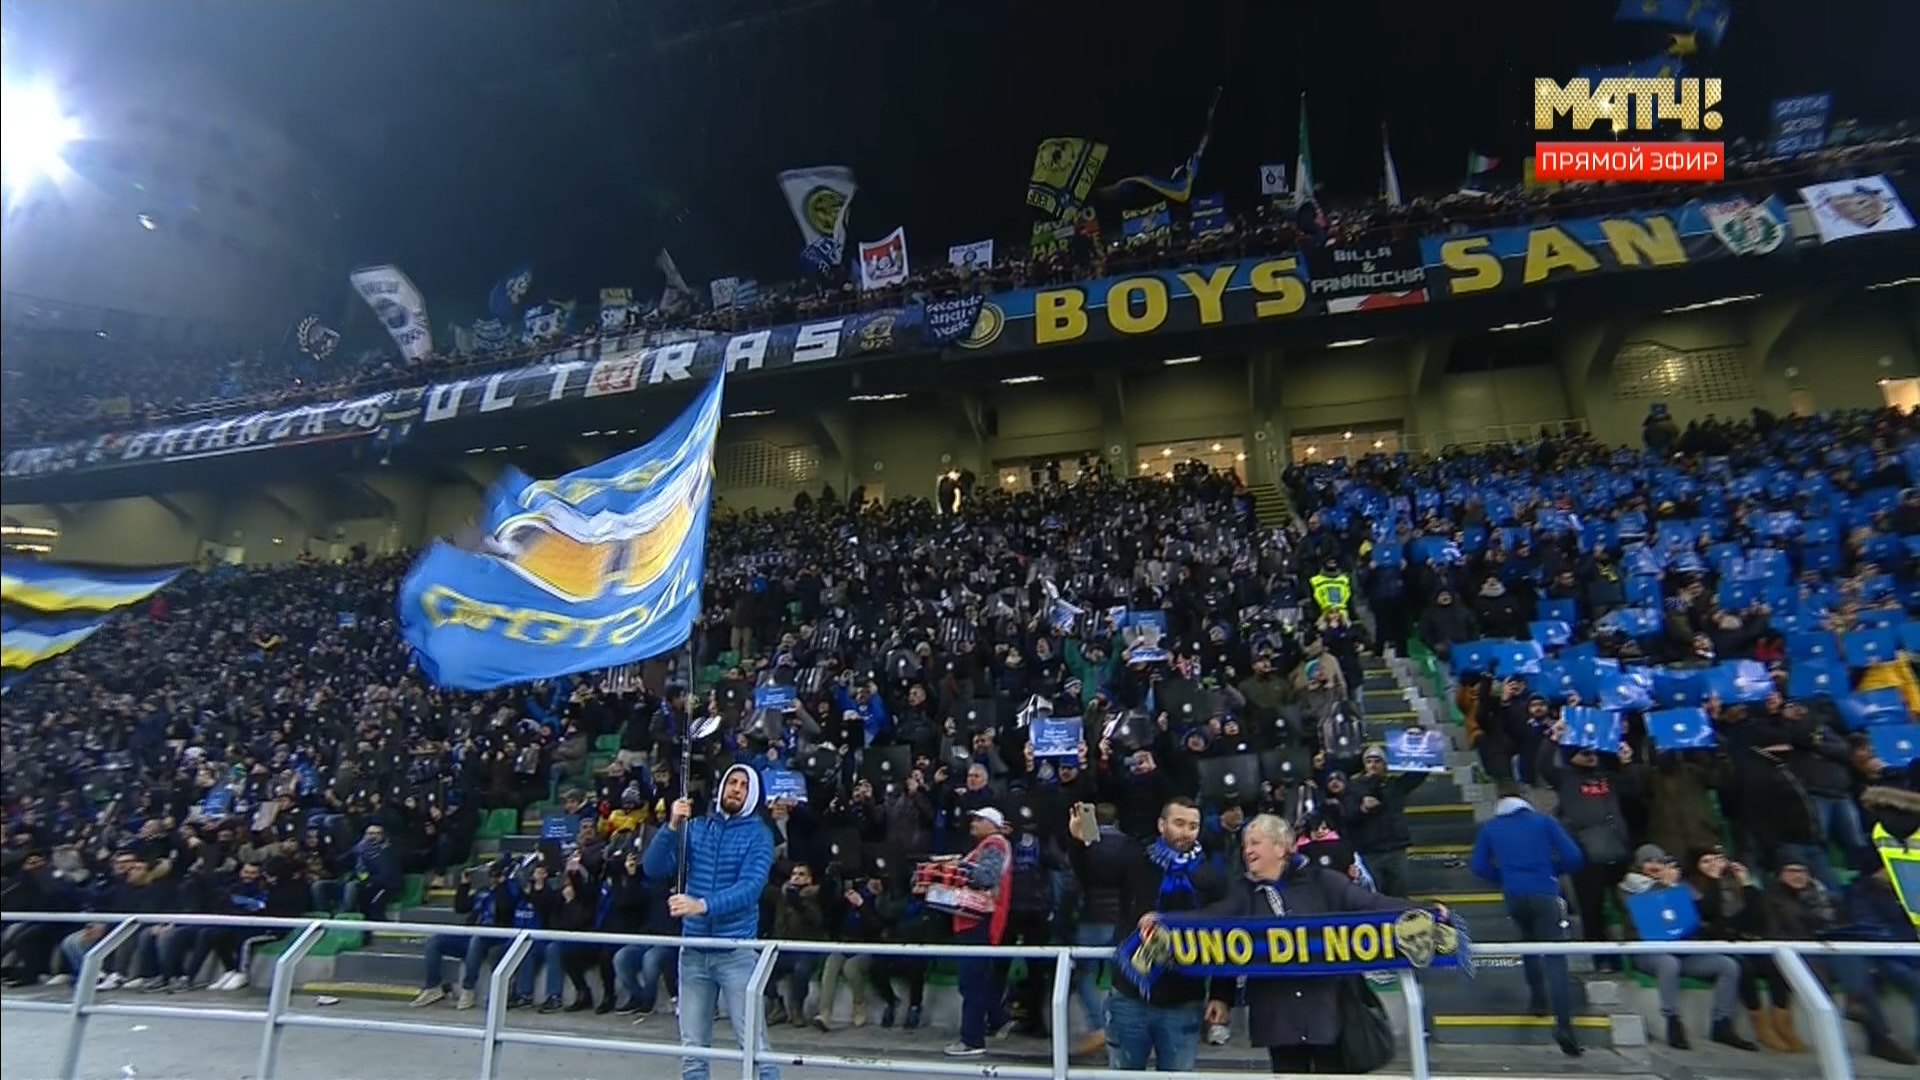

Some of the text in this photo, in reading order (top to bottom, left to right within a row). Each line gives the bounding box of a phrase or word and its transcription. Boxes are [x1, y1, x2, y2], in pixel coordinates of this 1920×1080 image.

[1334, 246, 1392, 262] BILLA
[1361, 261, 1376, 273] &
[1035, 257, 1307, 344] BOYS
[1441, 216, 1689, 294] SAN
[1171, 923, 1395, 965] UNO DI NOI
